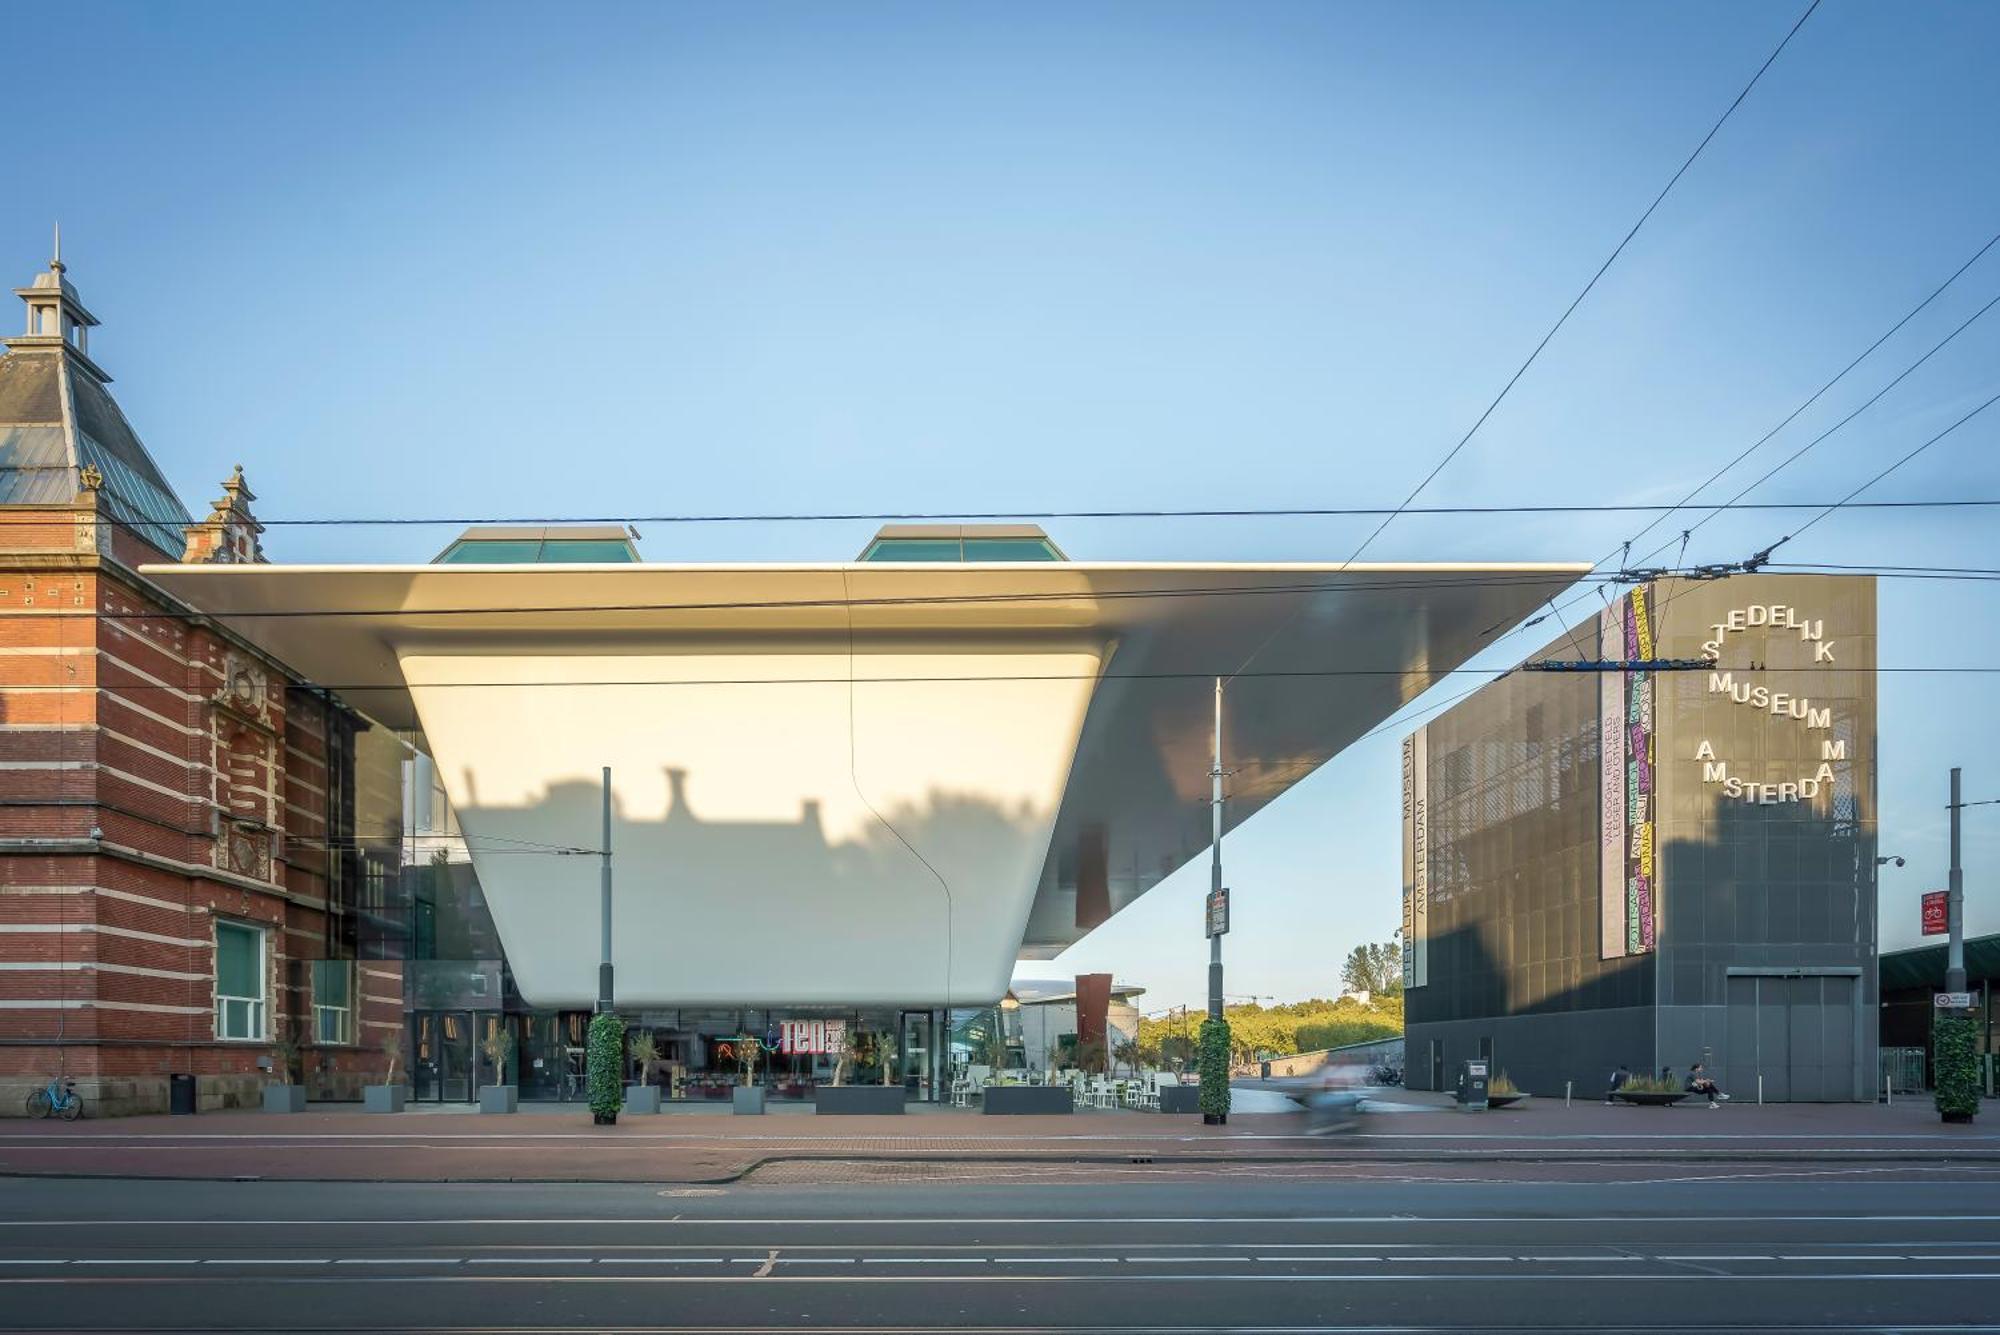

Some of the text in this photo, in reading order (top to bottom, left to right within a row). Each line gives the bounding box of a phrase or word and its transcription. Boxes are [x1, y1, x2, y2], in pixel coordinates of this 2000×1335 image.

[1701, 605, 1835, 663] STEDELIJK
[1640, 681, 1650, 734] KOONS
[1709, 672, 1831, 729] MUSEUM
[1403, 739, 1412, 820] MUSEUM
[1613, 716, 1621, 837] LEGER AND OTHERS
[1695, 739, 1845, 805] AMSTERDAM
[1416, 799, 1425, 915] AMSTERDAM
[1605, 822, 1613, 847] VAN
[1642, 822, 1651, 876] DUMAS
